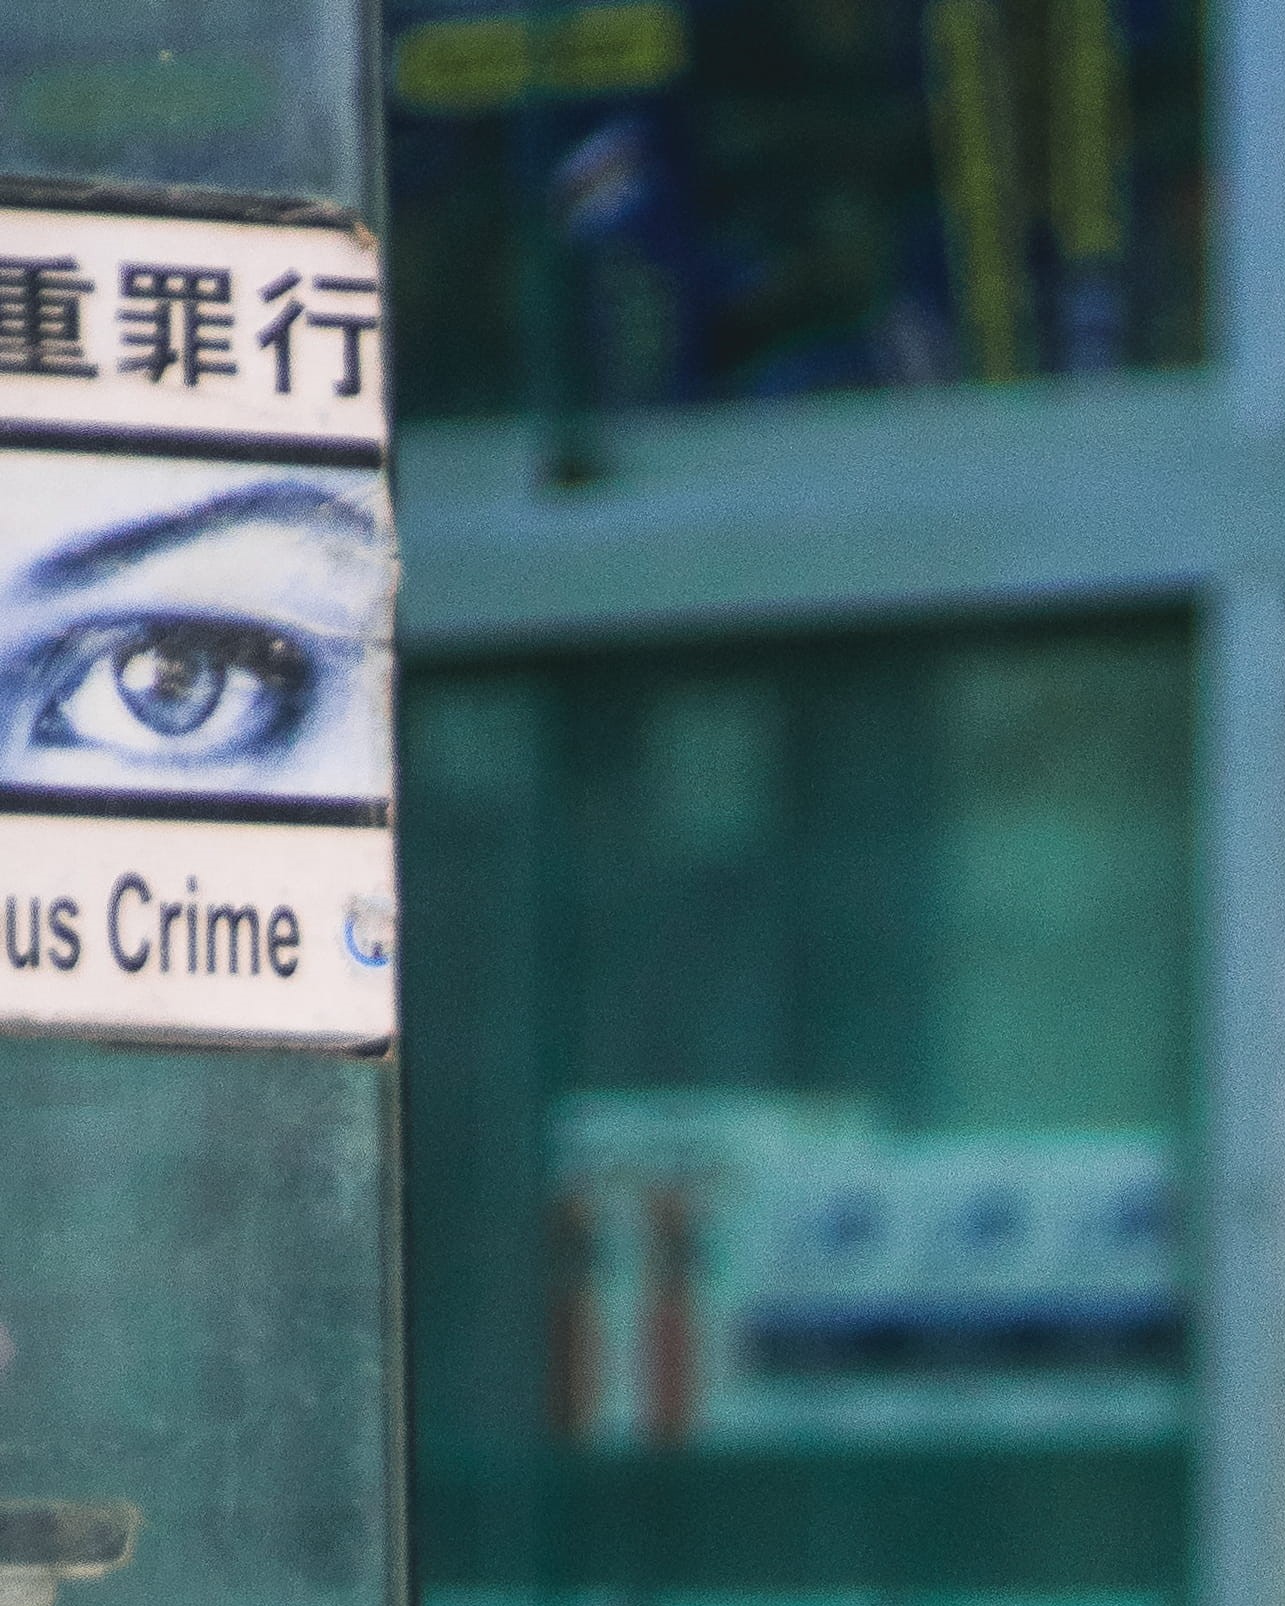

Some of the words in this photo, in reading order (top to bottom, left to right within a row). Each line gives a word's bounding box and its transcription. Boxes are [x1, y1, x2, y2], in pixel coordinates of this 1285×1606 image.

[0, 256, 378, 397] 重罪行
[5, 896, 81, 971] us
[107, 871, 300, 978] Crime
